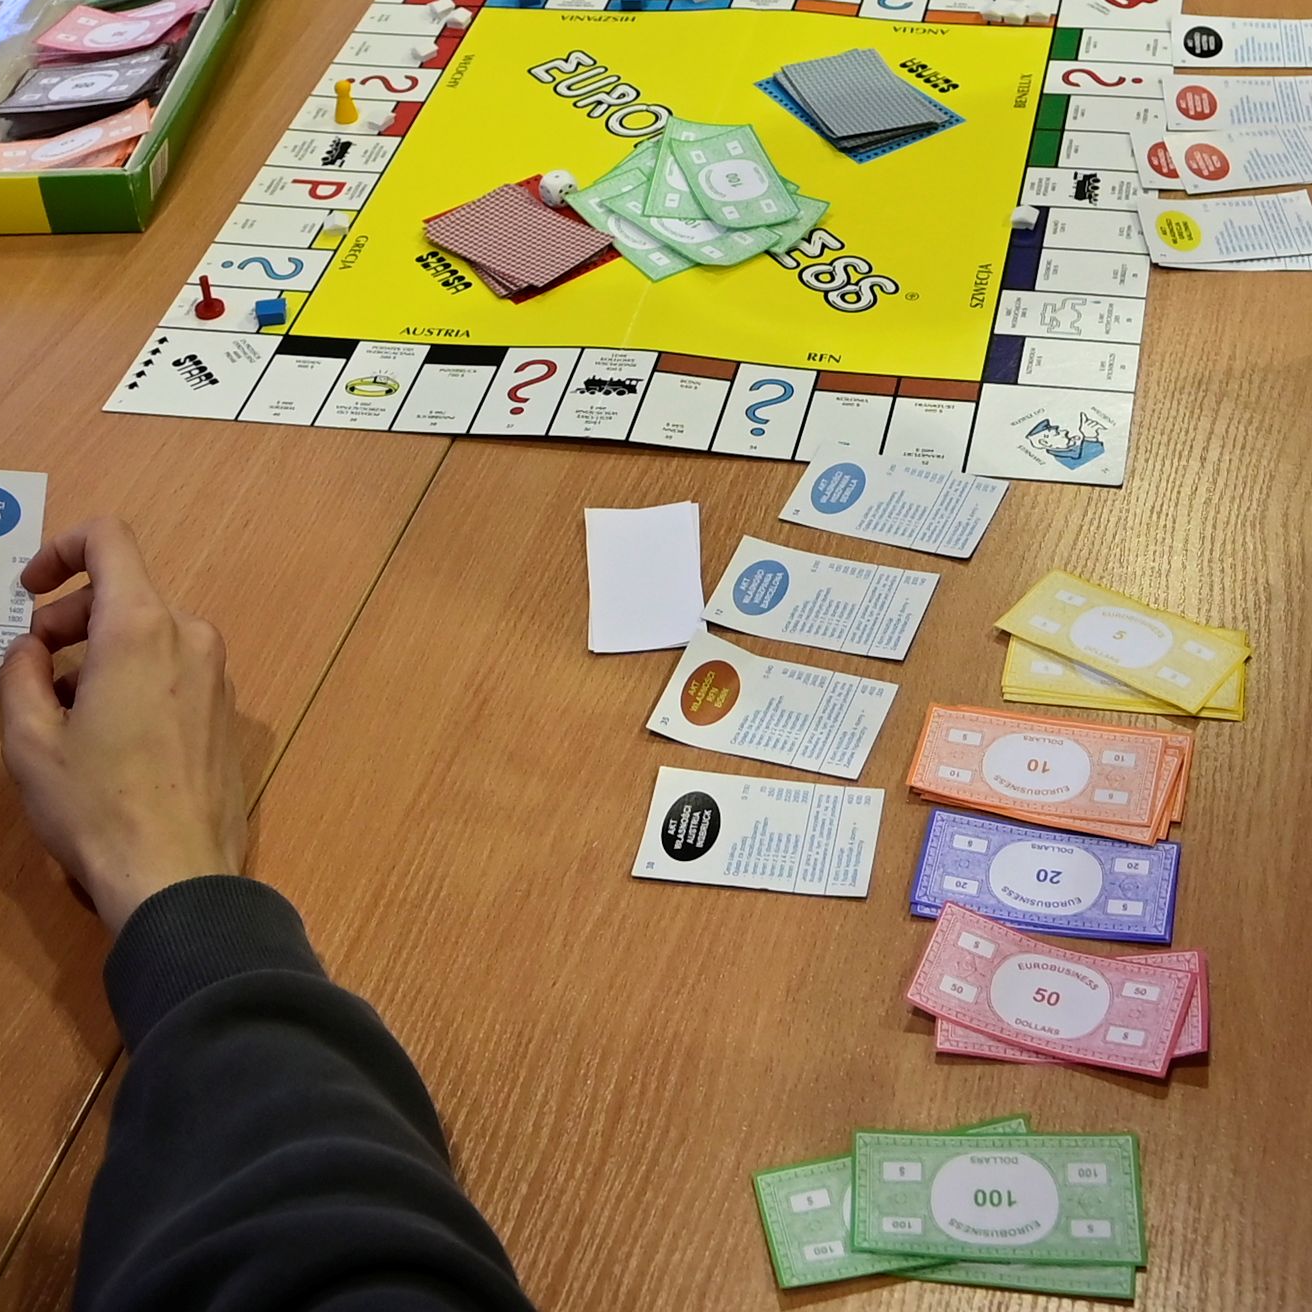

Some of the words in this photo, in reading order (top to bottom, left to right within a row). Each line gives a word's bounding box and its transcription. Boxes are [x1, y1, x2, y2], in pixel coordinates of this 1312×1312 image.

[561, 14, 636, 23] HISZPANIA
[892, 26, 950, 36] ANGLIA
[898, 56, 960, 94] SZANSA
[1013, 73, 1034, 109] BENELUX
[338, 233, 369, 272] GRECJA
[414, 250, 475, 296] SZANSA
[969, 262, 993, 310] SZWECJA
[399, 325, 472, 340] AUSTRIA
[806, 351, 842, 366] RFN
[171, 353, 220, 391] START
[1111, 628, 1127, 642] 5
[686, 678, 700, 696] AKT
[1022, 733, 1063, 746] DOLLARS
[1026, 756, 1051, 774] 10
[1113, 753, 1126, 762] 10
[948, 769, 960, 777] 10
[991, 773, 1070, 800] EUROBUSINESS
[667, 818, 677, 835] AKT
[686, 810, 701, 844] AUSTRIA
[1030, 842, 1073, 854] DOLLARS
[1126, 861, 1139, 870] 20
[954, 879, 968, 888] 20
[1035, 868, 1062, 884] 20
[998, 884, 1082, 910] EUROBUSINESS
[1015, 959, 1101, 991] EUROBUSINESS
[949, 983, 964, 994] 50
[1031, 986, 1061, 1007] 50
[1133, 986, 1148, 996] 50
[1013, 1017, 1061, 1036] DOLLARS
[968, 1155, 1018, 1164] DOLLARS
[1077, 1167, 1098, 1178] 100
[973, 1188, 1016, 1207] 100
[891, 1220, 912, 1228] 100
[947, 1216, 1040, 1237] EUROBUSINESS
[812, 1245, 834, 1255] 100
